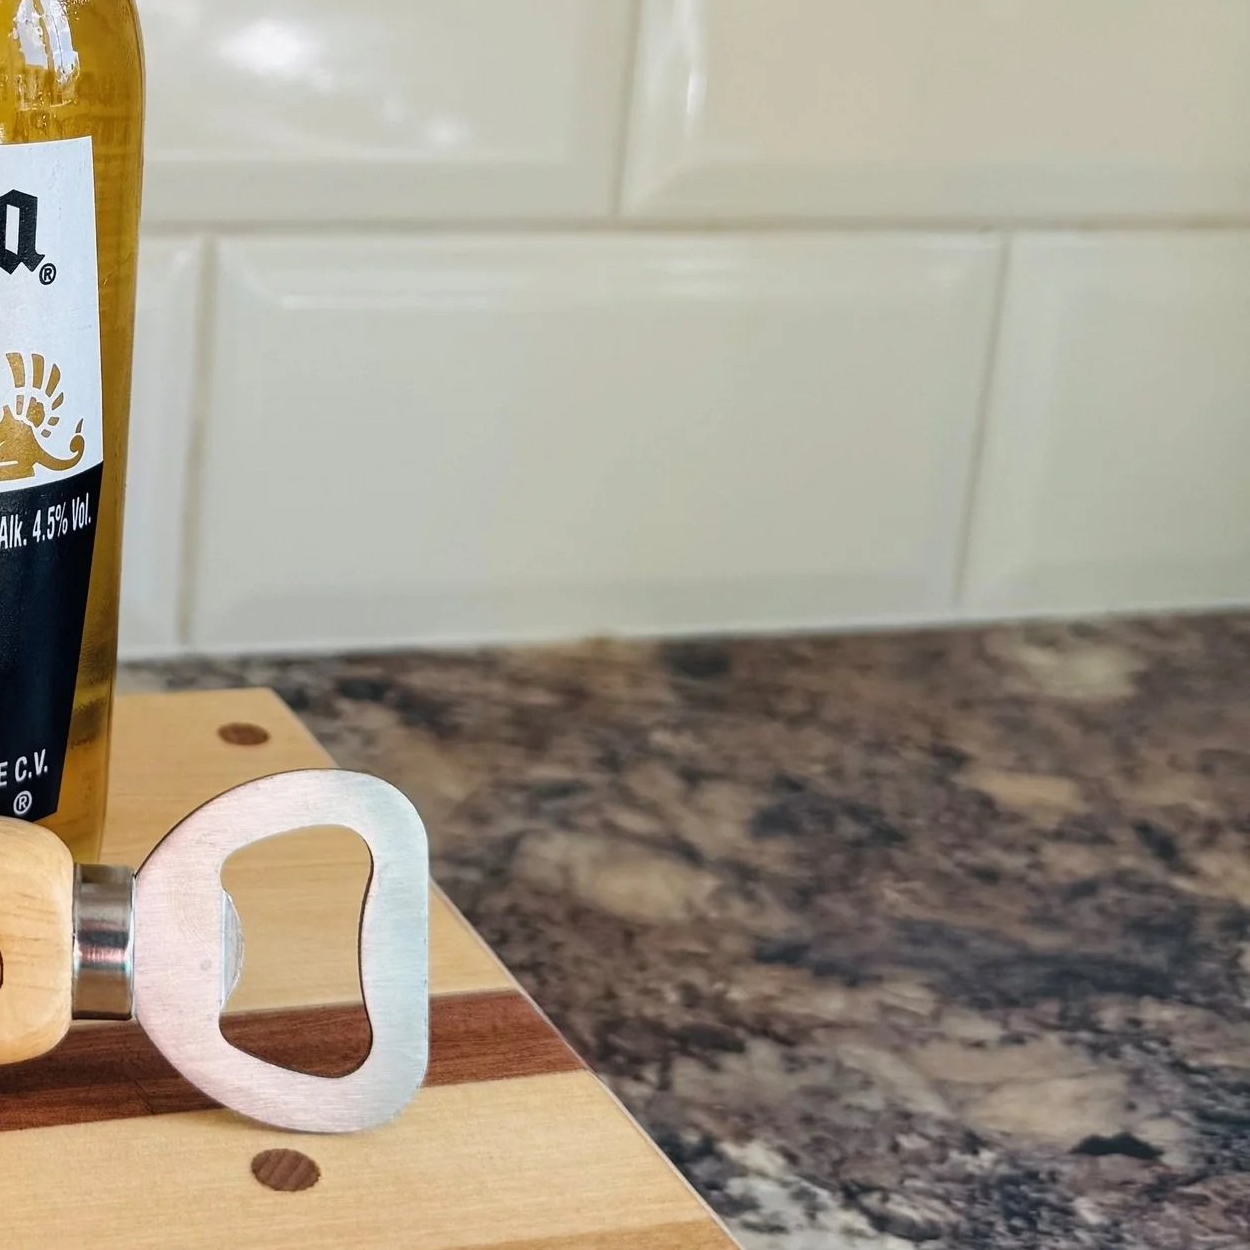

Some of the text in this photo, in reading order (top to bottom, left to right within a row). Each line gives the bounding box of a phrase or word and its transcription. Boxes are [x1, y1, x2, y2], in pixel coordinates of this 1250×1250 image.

[32, 502, 68, 543] 4.5%
[71, 492, 92, 532] Vol.
[15, 748, 48, 783] C.V.
